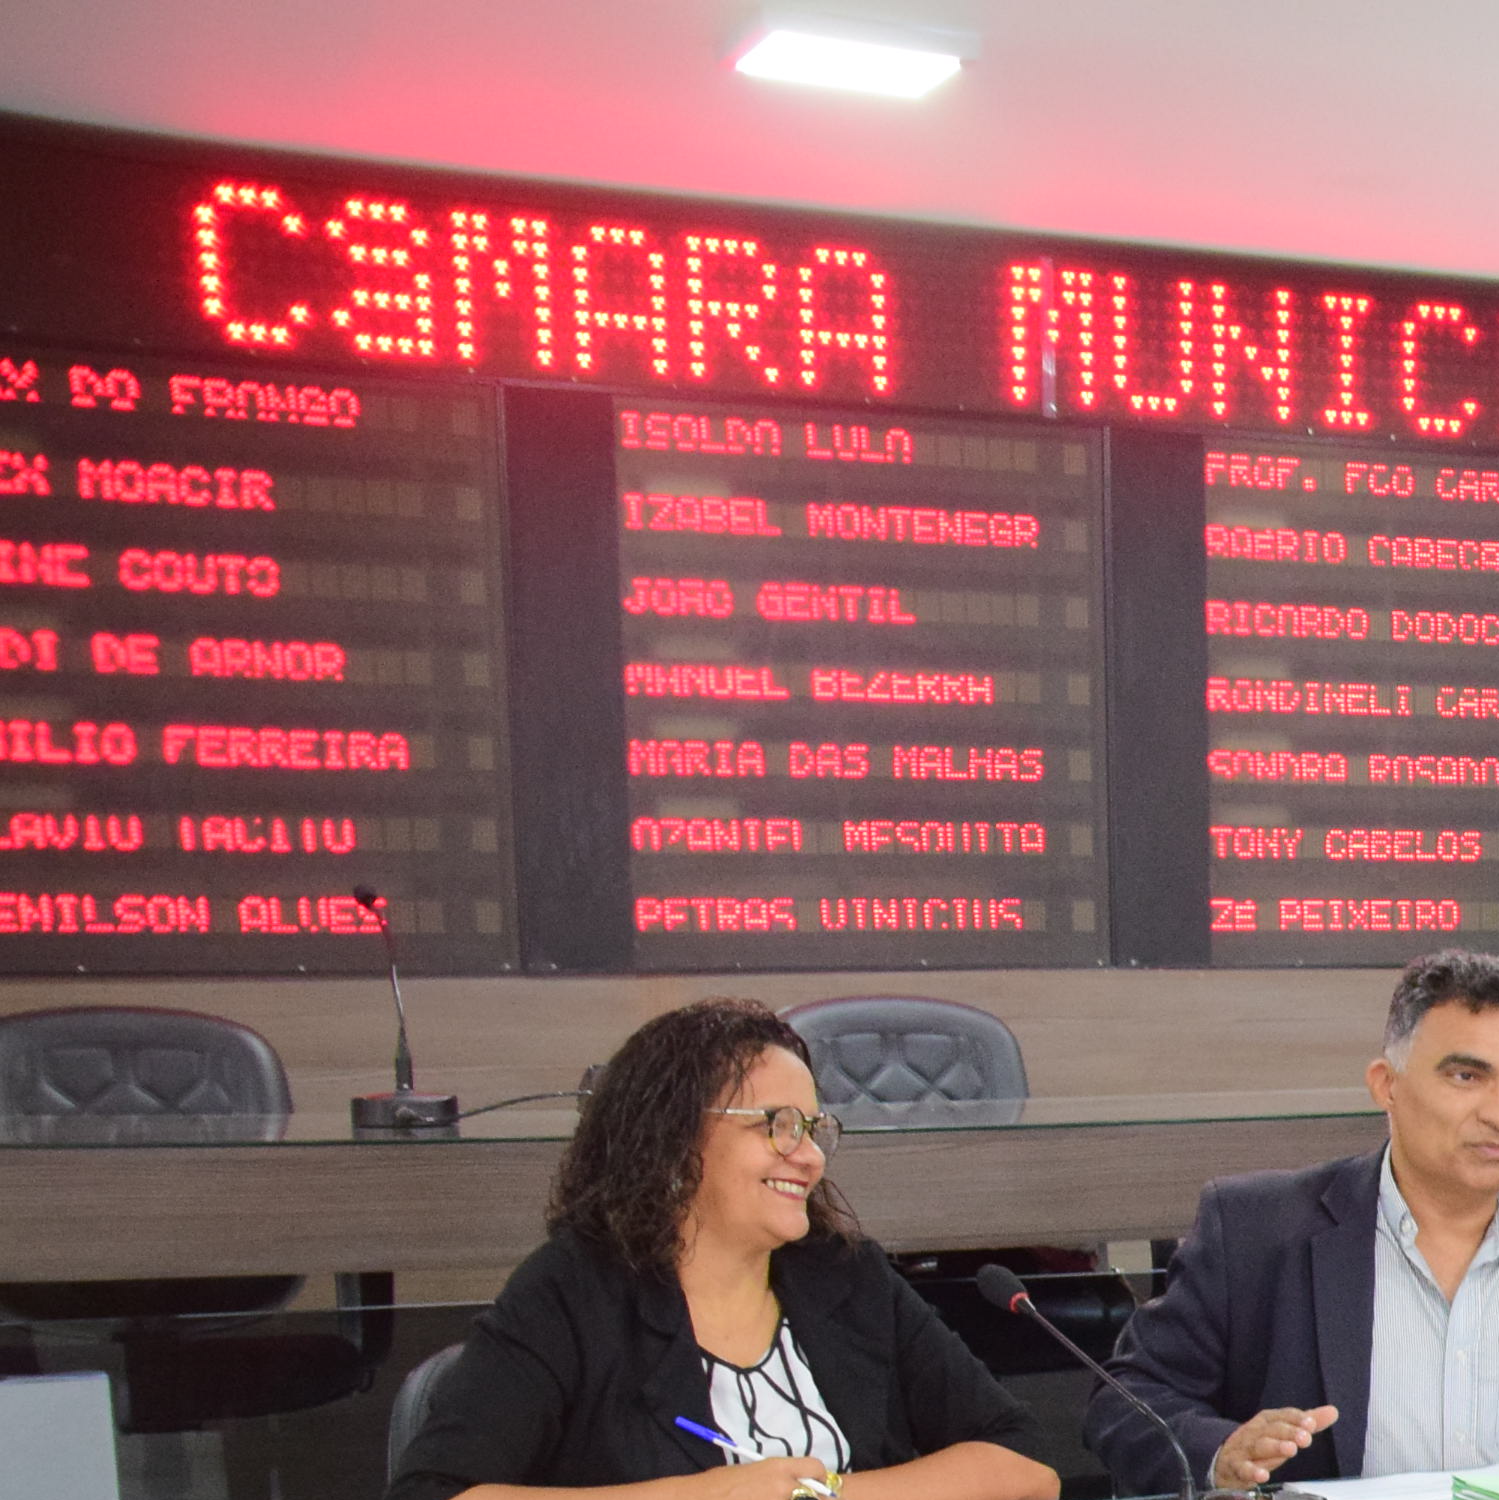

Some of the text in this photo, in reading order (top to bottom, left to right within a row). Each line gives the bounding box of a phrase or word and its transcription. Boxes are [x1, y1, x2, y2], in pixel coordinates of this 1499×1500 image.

[76, 457, 277, 512] MOACIR
[621, 491, 782, 536] IZABEL
[117, 547, 281, 598] COUTO
[755, 581, 916, 625] GENTIL
[1205, 600, 1370, 640] RICARDO
[90, 631, 160, 675] DE
[1205, 677, 1411, 716] RONDINELI
[0, 718, 410, 771] ILIO FERREIRA
[628, 739, 1044, 782] MARIA DAS MALHAS
[1209, 825, 1482, 862] TONY CABELOS
[1279, 898, 1461, 931] PEIXEIRO
